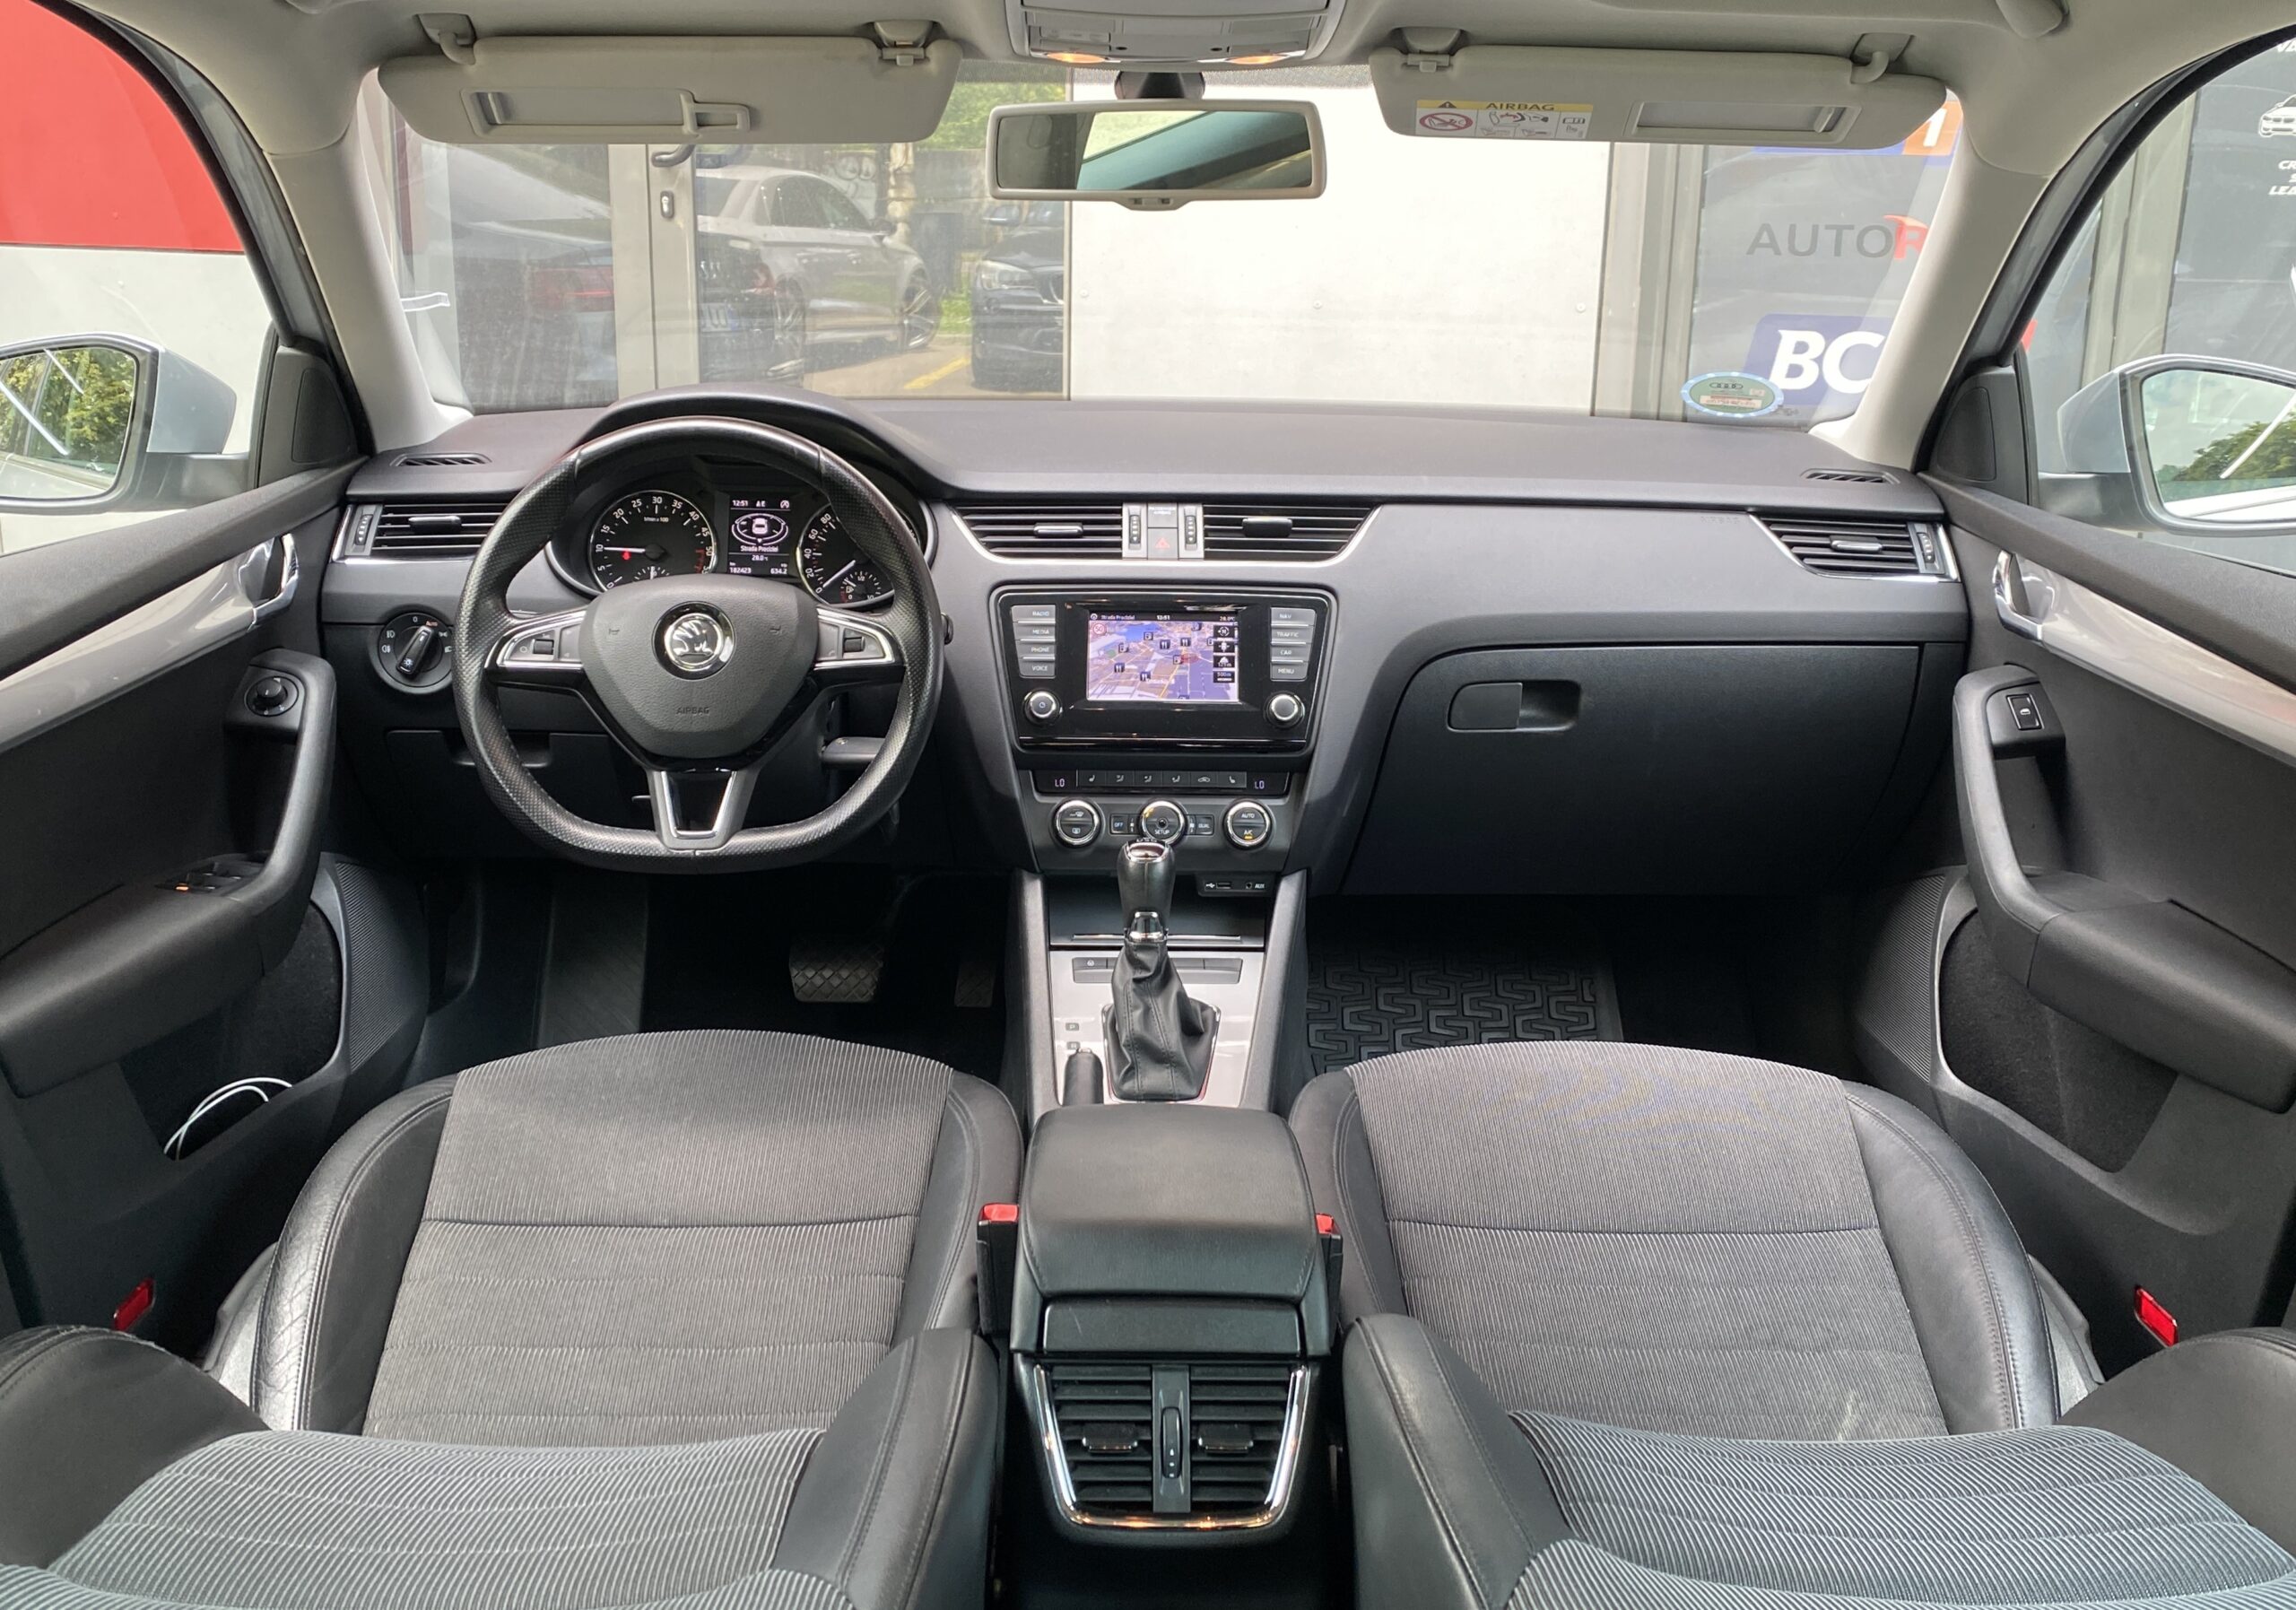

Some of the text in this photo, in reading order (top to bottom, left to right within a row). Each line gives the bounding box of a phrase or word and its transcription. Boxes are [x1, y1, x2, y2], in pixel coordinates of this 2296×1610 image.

[1486, 102, 1554, 111] AIRBAG
[1770, 329, 1886, 394] BC
[631, 499, 642, 508] 25
[652, 496, 662, 504] 30
[672, 500, 683, 509] 35
[613, 508, 624, 518] 20
[689, 510, 700, 520] 40
[820, 513, 831, 524] 80
[600, 525, 611, 534] 15
[701, 527, 709, 536] 45
[808, 528, 818, 539] 60
[596, 544, 604, 553] 10
[706, 546, 714, 556] 50
[804, 549, 812, 559] 40
[805, 568, 814, 579] 20
[676, 706, 709, 715] AIRBAG
[1055, 779, 1065, 788] LO
[1255, 780, 1265, 789] LO
